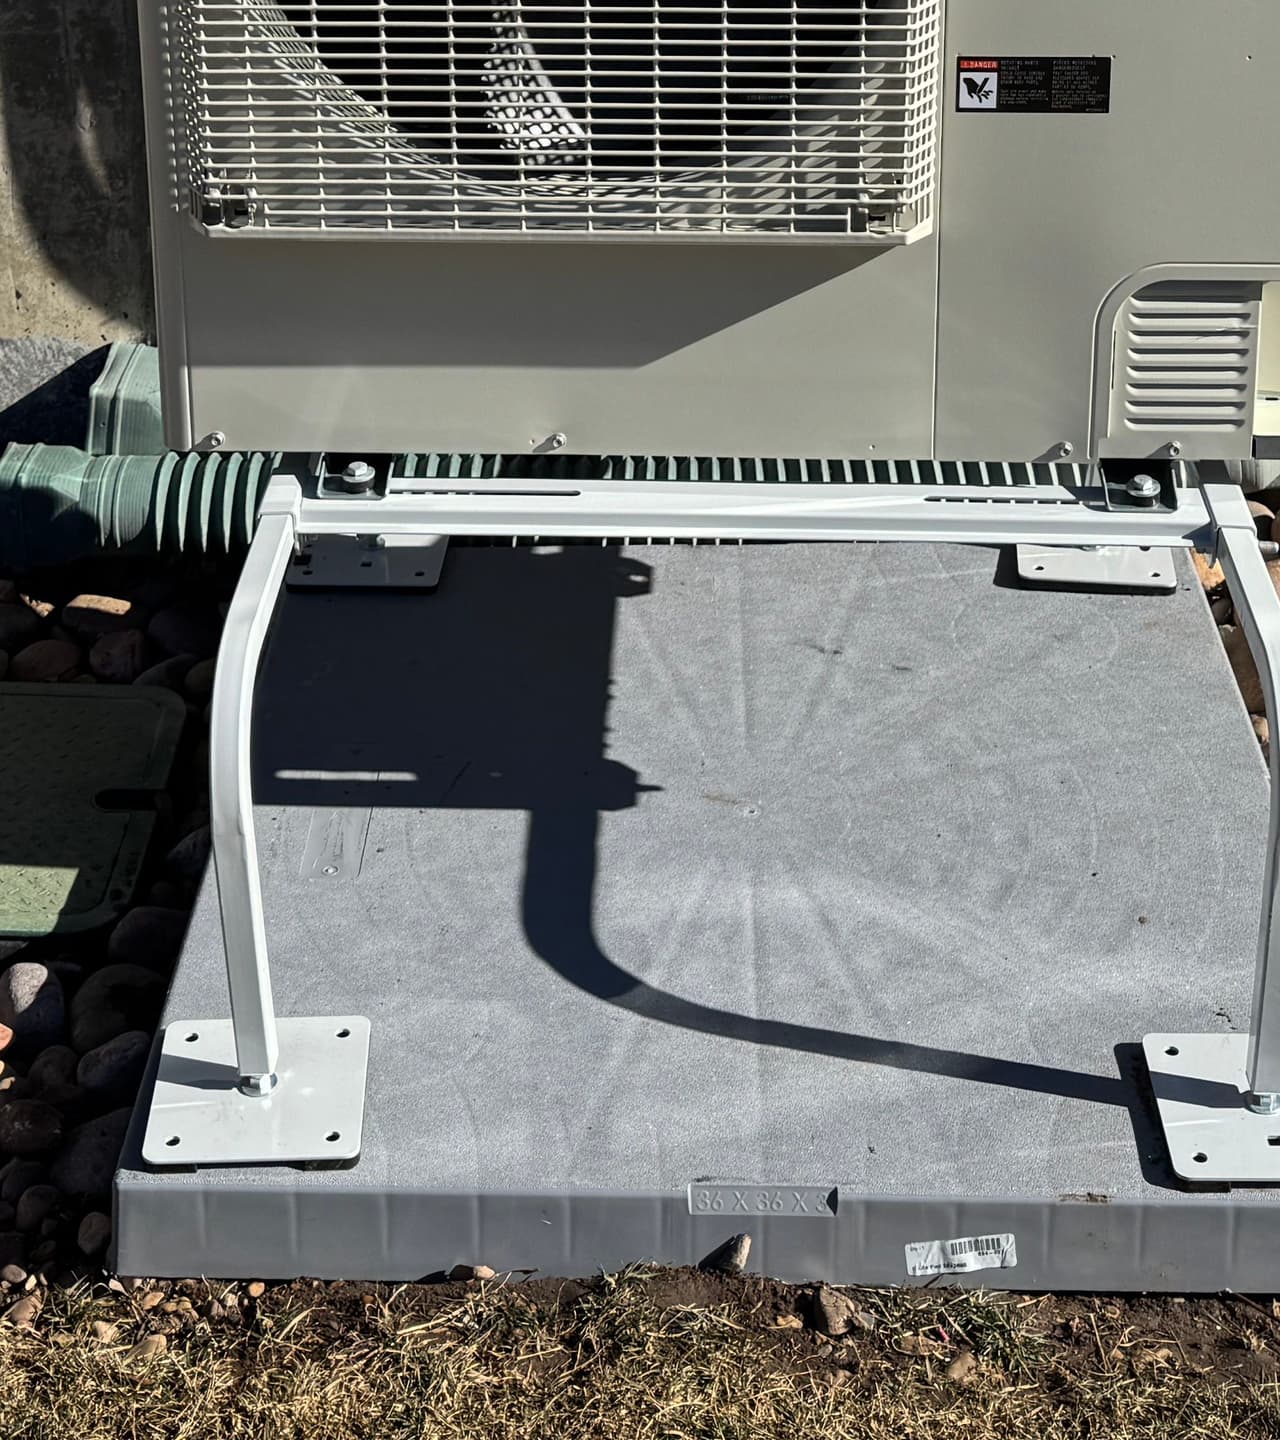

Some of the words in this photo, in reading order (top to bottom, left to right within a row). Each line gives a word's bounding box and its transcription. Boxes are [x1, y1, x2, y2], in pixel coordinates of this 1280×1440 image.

[696, 1190, 724, 1211] 36
[732, 1190, 749, 1212] X
[756, 1191, 784, 1211] 36
[792, 1191, 809, 1213] X
